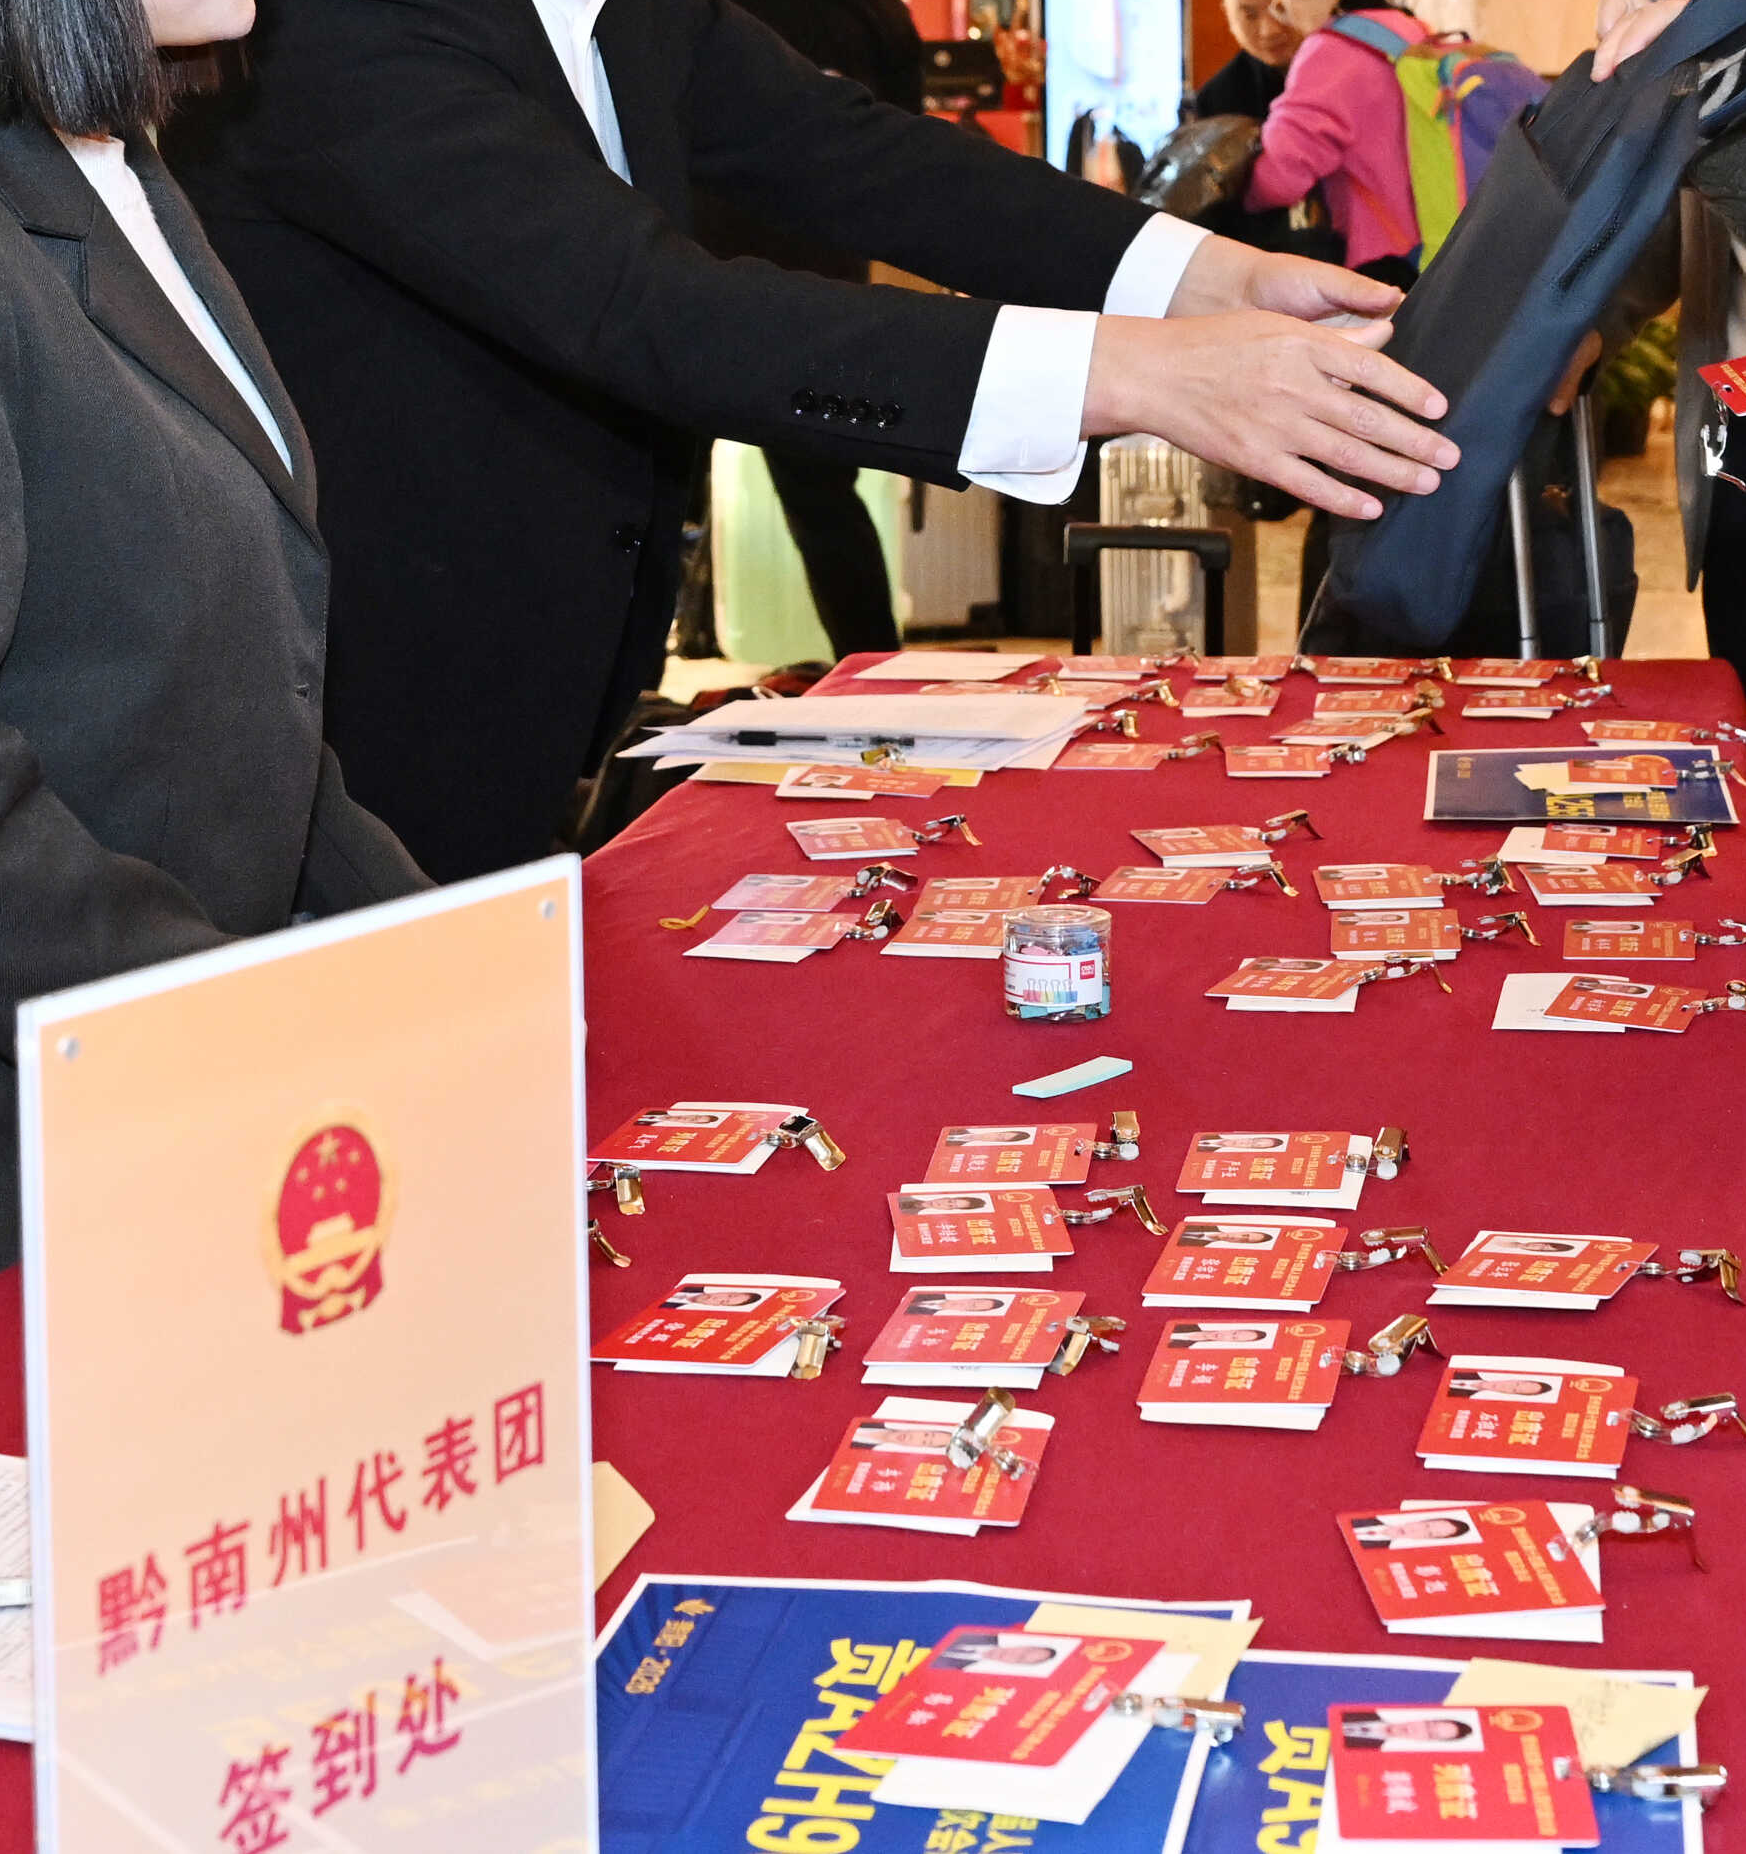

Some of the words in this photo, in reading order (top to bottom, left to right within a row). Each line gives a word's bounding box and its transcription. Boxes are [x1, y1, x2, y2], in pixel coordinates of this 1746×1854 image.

[965, 1218, 997, 1245] 出席证
[1221, 1256, 1261, 1286] 出席证
[667, 1319, 721, 1349] 出席证
[1221, 1356, 1262, 1390] 出席证
[1505, 1409, 1546, 1446] 出席证
[97, 1381, 545, 1677] 黔南州代表团
[219, 1655, 463, 1854] 签到处
